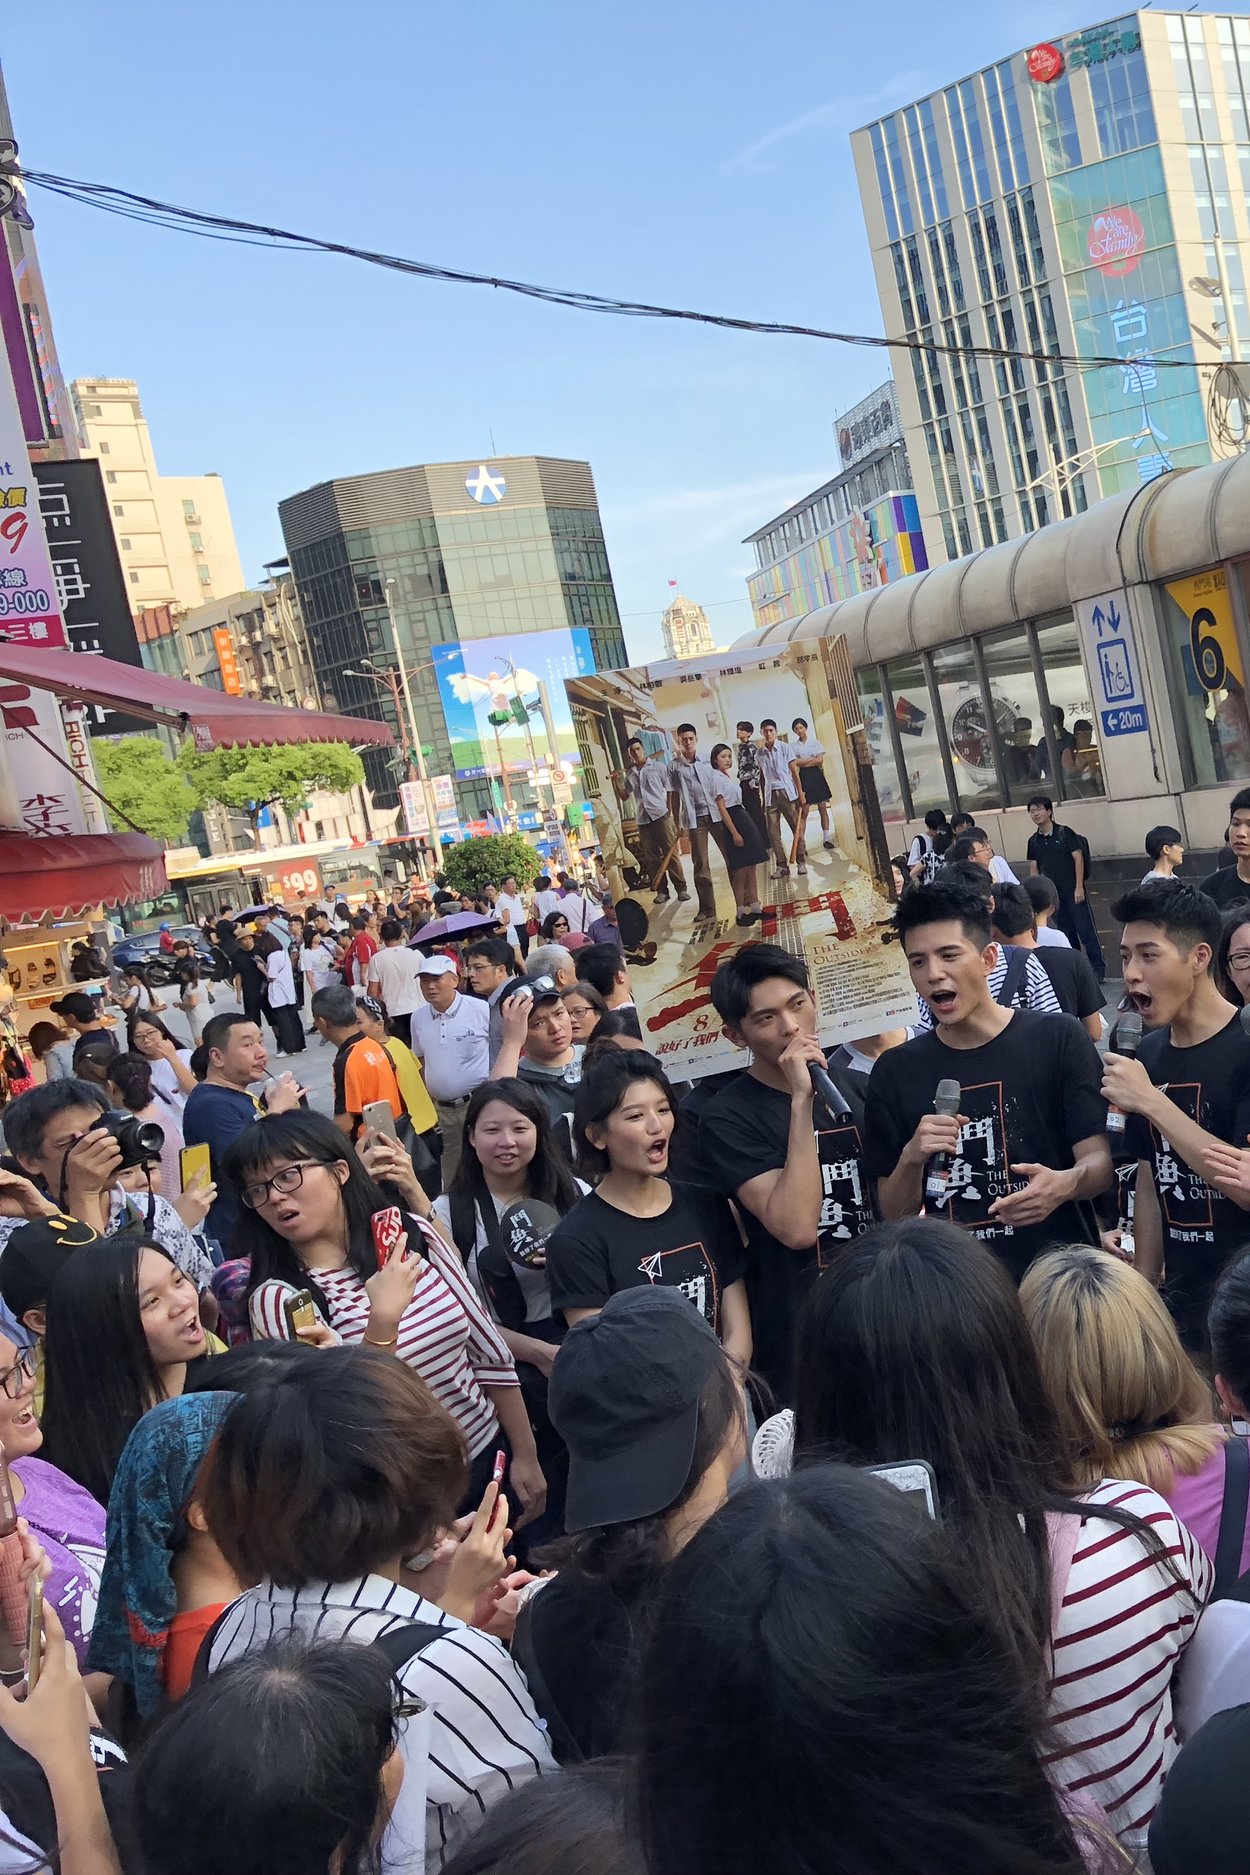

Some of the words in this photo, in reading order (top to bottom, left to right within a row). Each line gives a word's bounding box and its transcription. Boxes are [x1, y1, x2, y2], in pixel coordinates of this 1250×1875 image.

[1190, 607, 1225, 691] 6
[1118, 712, 1144, 730] 20m
[812, 943, 840, 956] THE
[986, 1169, 1008, 1182] THE
[987, 1180, 1030, 1196] OUTSID
